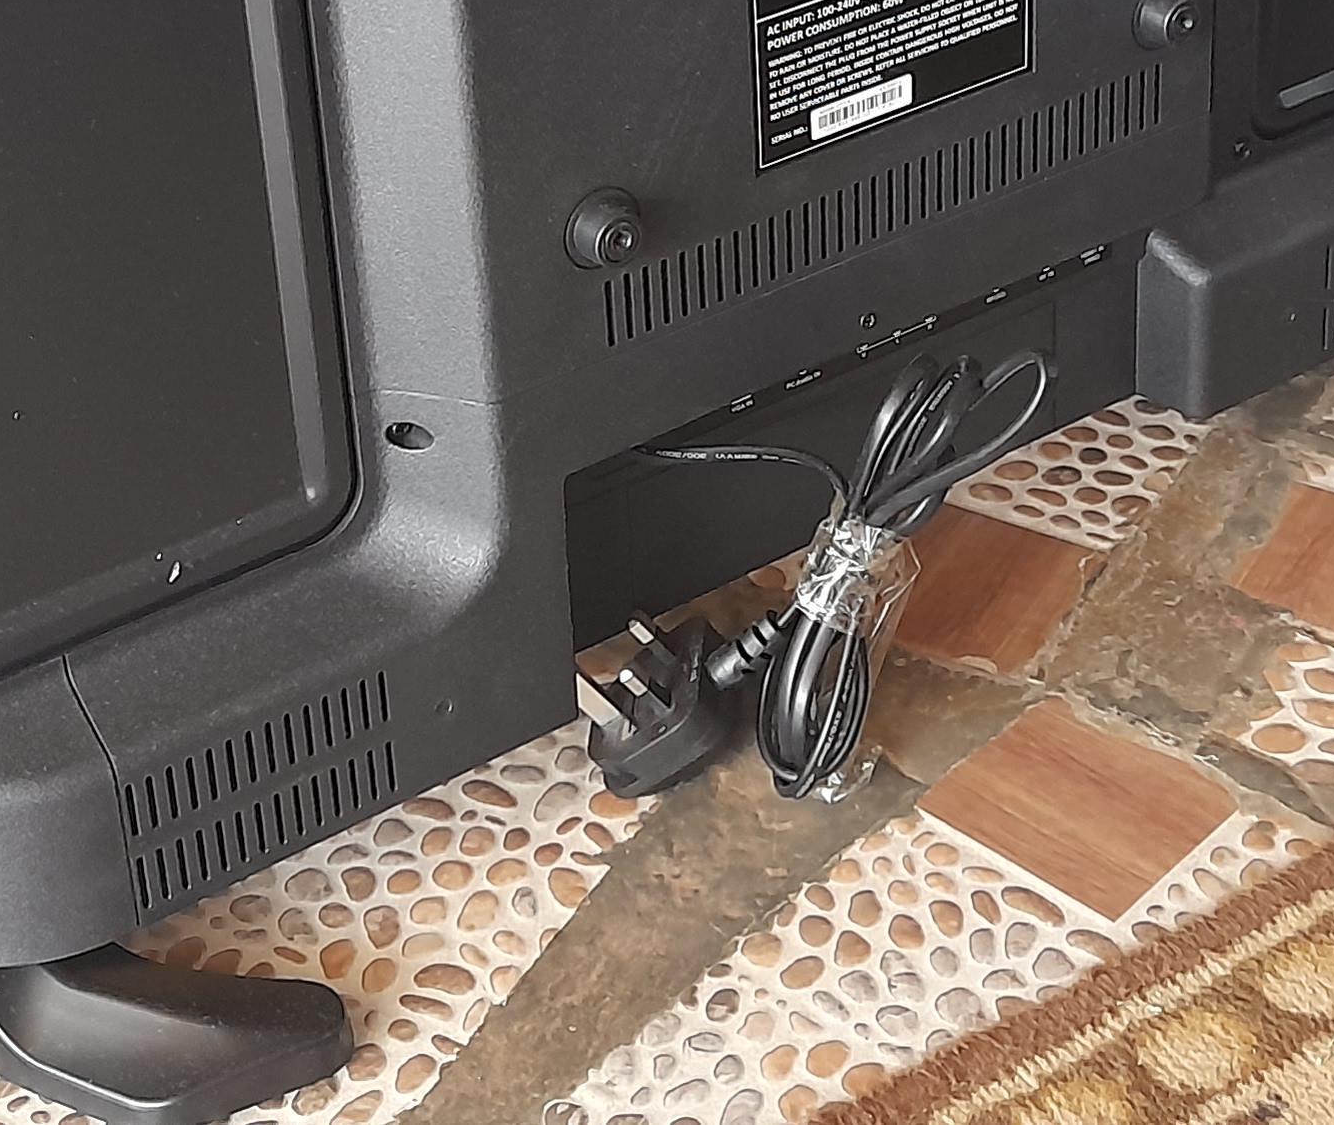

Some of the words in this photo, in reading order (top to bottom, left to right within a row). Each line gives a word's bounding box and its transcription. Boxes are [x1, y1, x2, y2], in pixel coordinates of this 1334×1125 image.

[767, 23, 781, 37] AC
[782, 12, 815, 31] INPUT:
[767, 30, 804, 51] POWER
[805, 4, 881, 37] CONSUMPTION:
